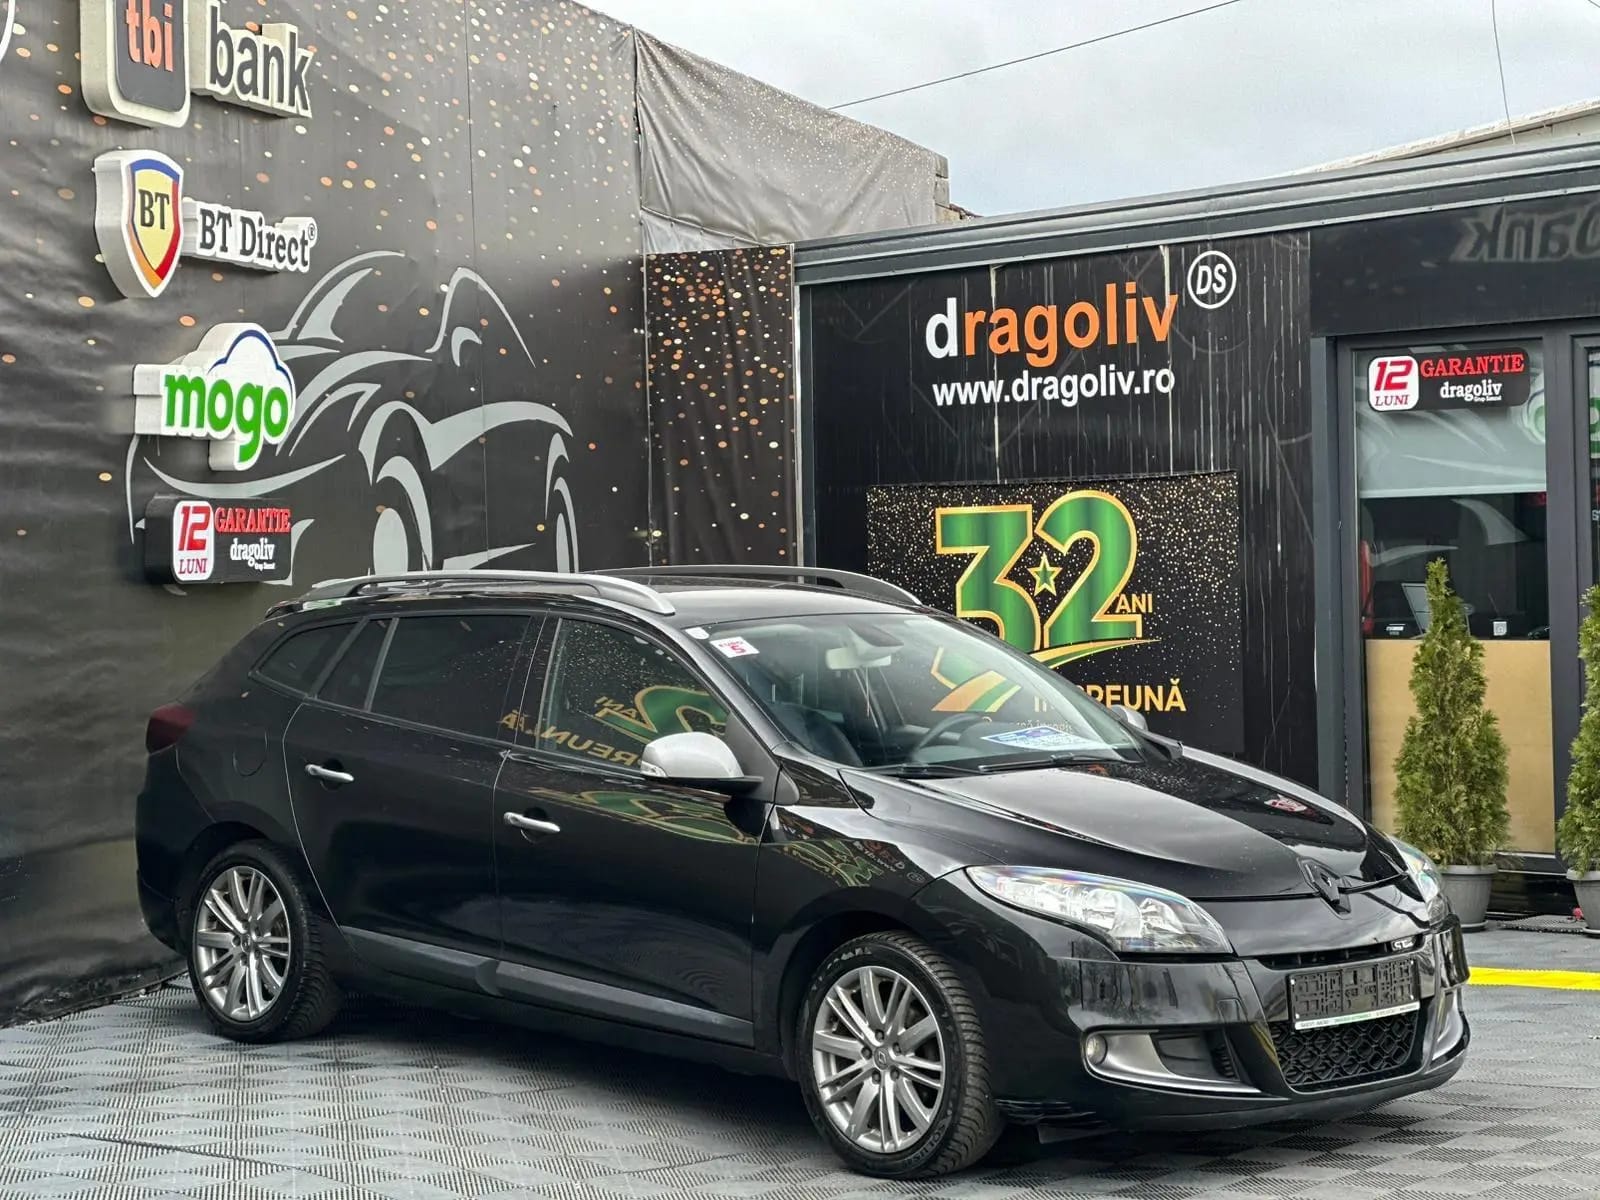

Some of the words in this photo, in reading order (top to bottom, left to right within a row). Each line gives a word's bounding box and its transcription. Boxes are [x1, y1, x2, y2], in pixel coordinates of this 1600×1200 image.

[125, 0, 174, 72] tbi
[209, 4, 310, 111] bank
[138, 189, 170, 230] BT
[199, 208, 233, 253] BT
[1196, 264, 1228, 295] DS
[925, 281, 1179, 368] dragoliv
[1374, 360, 1414, 391] 12
[1420, 353, 1524, 377] GARANTIE
[932, 364, 1176, 408] www.dragoliv.ro
[1374, 395, 1409, 407] LUNI
[1440, 379, 1503, 402] dragoliv
[164, 373, 289, 463] mogo
[178, 506, 211, 551] 12
[214, 507, 290, 532] GARANTIE
[177, 558, 208, 575] LUNI
[230, 537, 275, 567] dragoliv
[931, 490, 1142, 690] 32
[1115, 593, 1153, 613] ANI
